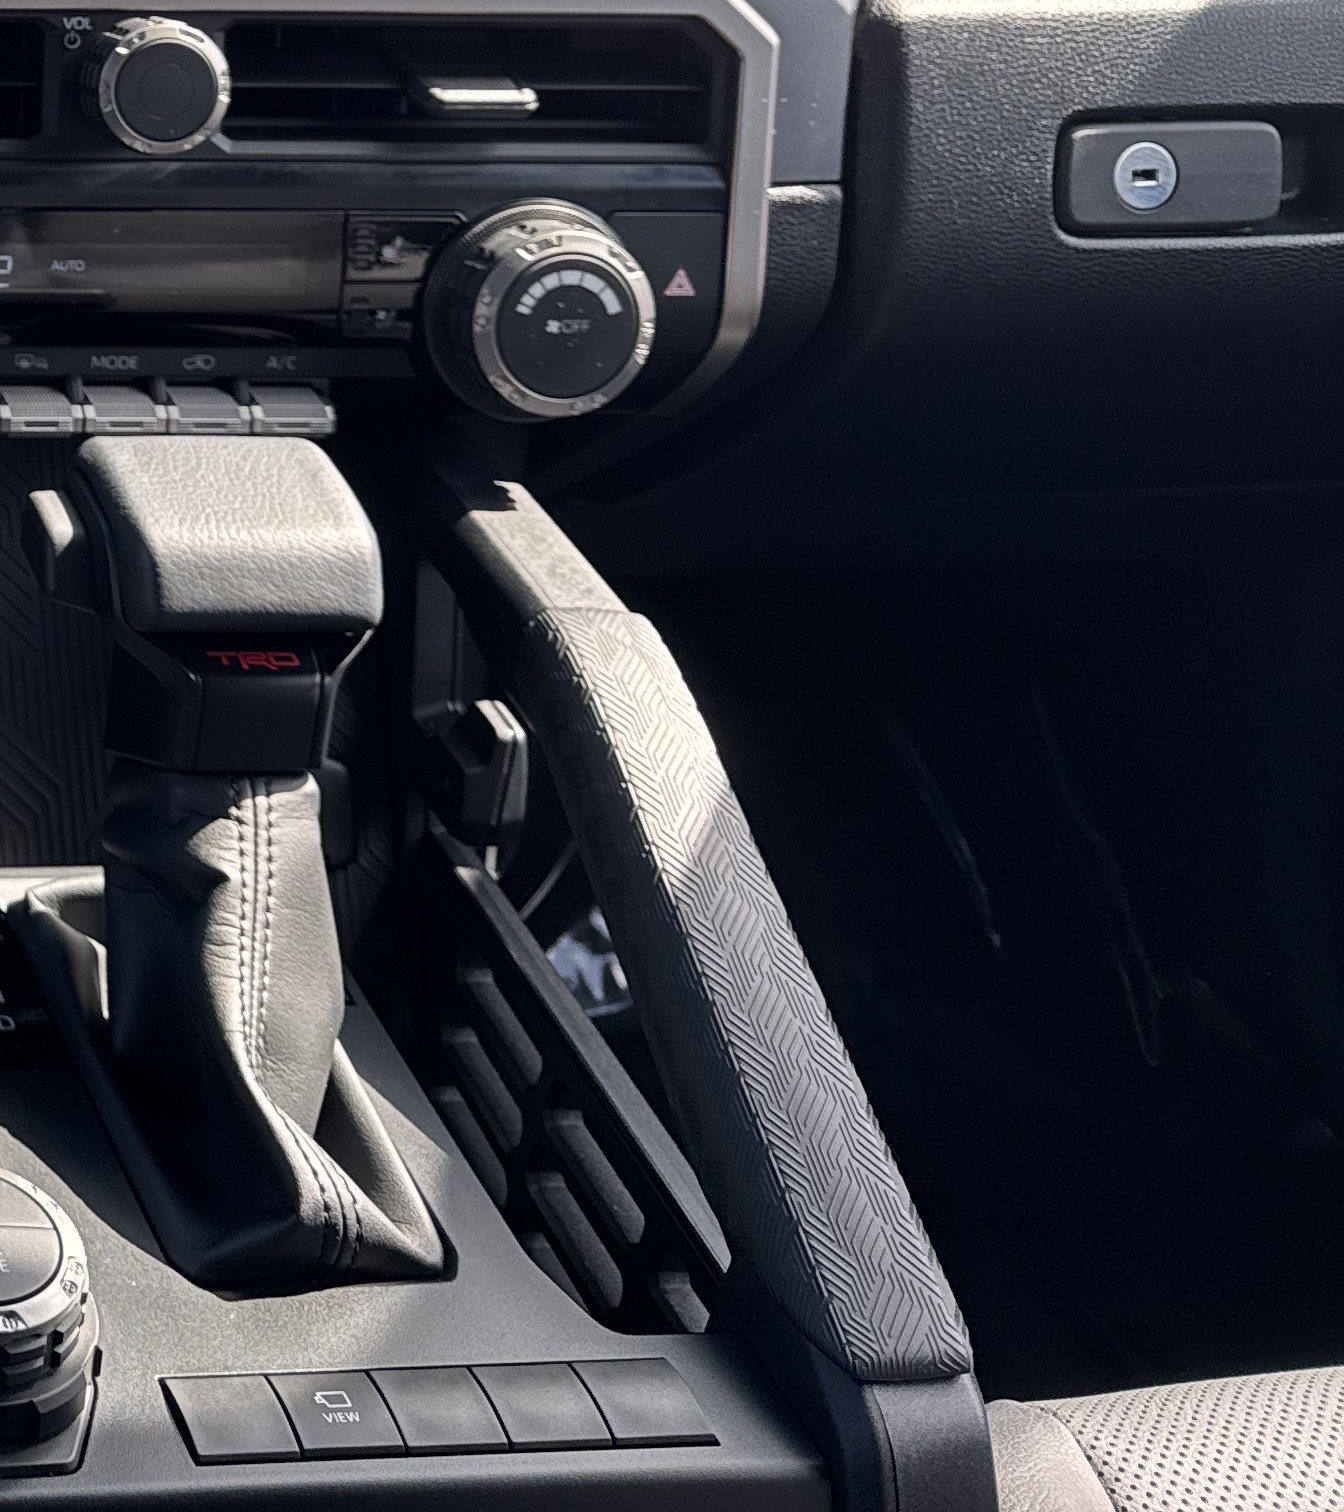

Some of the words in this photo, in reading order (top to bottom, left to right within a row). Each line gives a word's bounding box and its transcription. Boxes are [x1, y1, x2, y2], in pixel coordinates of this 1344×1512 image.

[62, 16, 93, 30] VOL
[51, 259, 85, 272] AUTO
[561, 319, 590, 334] OFF
[90, 355, 140, 371] MODE
[265, 355, 297, 371] A/C
[206, 651, 301, 671] TRD
[321, 1411, 361, 1424] VIEW
